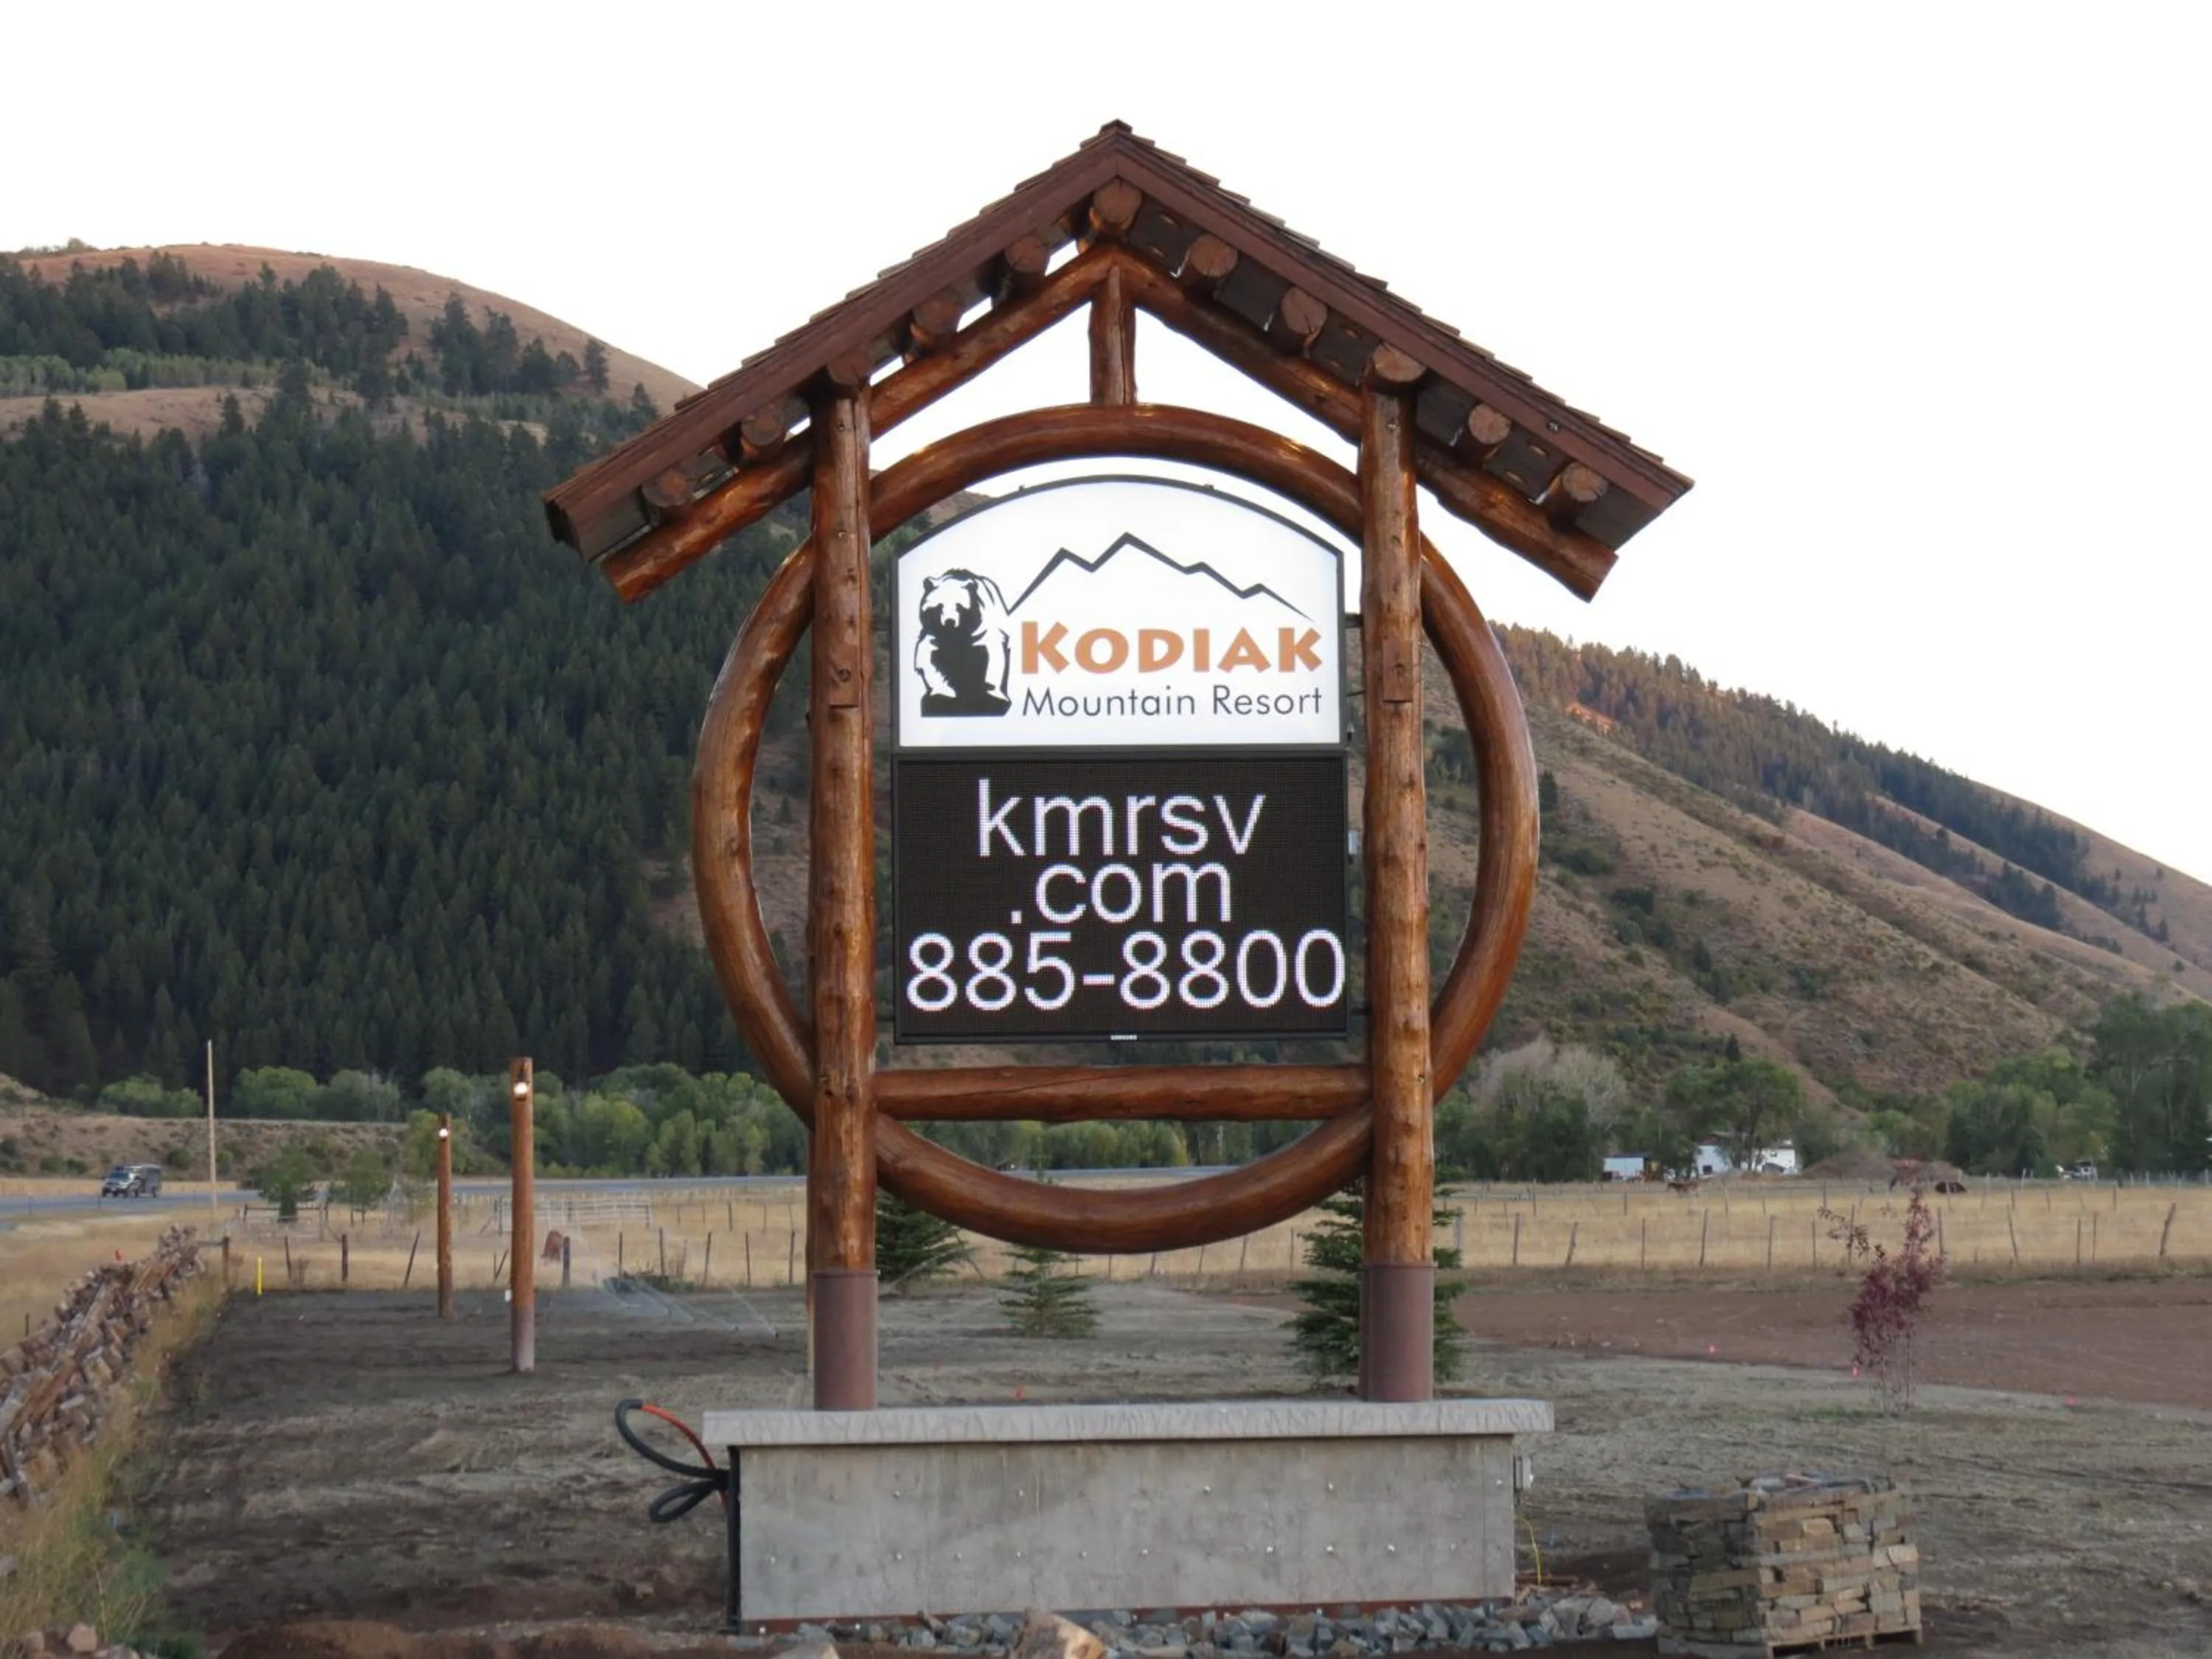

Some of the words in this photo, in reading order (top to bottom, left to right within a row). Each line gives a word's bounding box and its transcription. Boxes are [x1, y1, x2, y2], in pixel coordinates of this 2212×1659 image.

[1021, 621, 1322, 674] KODIAK
[1022, 685, 1195, 717] Mountain
[1213, 684, 1322, 715] Resort
[978, 778, 1266, 857] kmrsv
[1011, 862, 1231, 924] .com
[906, 929, 1346, 1012] 885-8800
